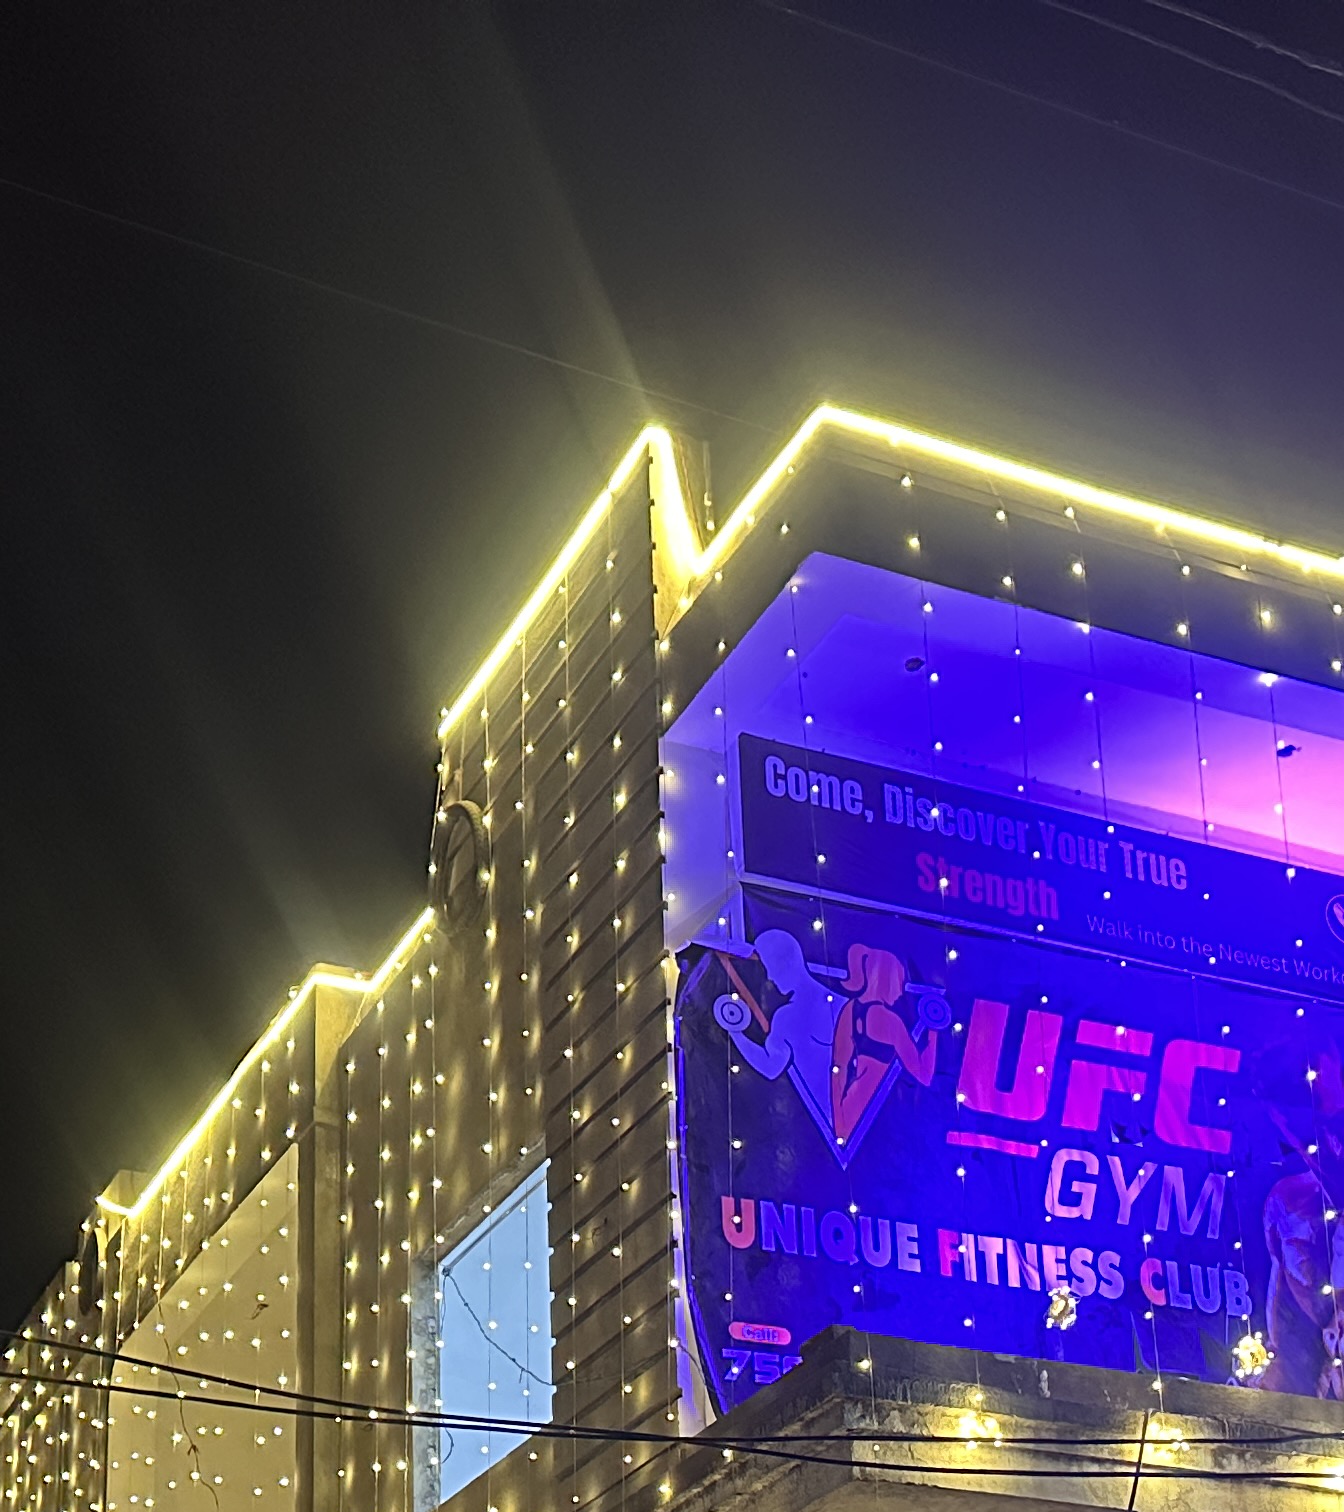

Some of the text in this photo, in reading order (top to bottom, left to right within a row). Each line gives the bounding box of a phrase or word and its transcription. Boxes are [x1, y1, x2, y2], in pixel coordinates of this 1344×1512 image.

[765, 755, 1188, 891] Come, Discover Your True
[915, 851, 1060, 921] Strength
[1086, 914, 1132, 941] Walk
[1138, 924, 1177, 950] into
[1181, 934, 1214, 957] the
[1219, 945, 1290, 975] Newest
[961, 999, 1242, 1155] UFC
[1044, 1148, 1227, 1240] GYM
[720, 1195, 1253, 1318] UNIQUE FITNESS CLUB
